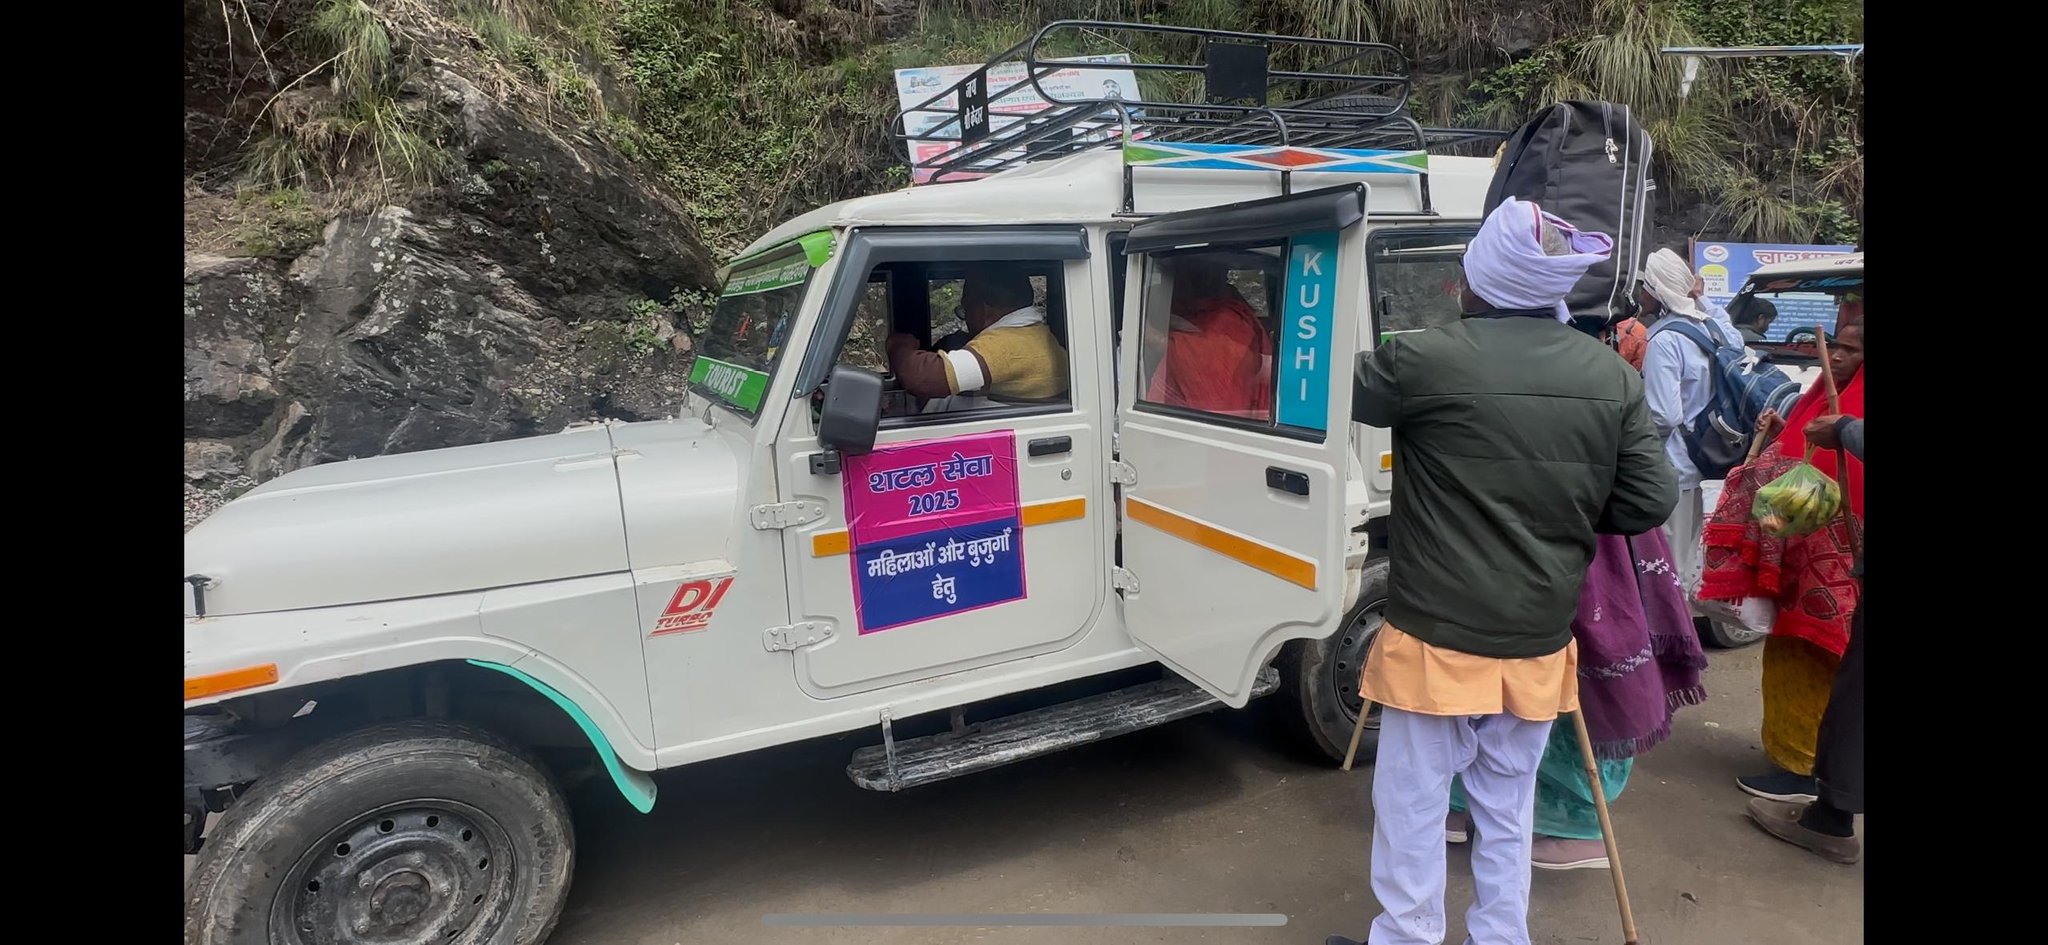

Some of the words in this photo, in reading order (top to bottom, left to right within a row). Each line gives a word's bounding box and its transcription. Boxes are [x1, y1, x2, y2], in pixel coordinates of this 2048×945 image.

[965, 78, 977, 98] जय
[971, 105, 983, 127] केदार
[1295, 252, 1322, 401] KUSHI
[704, 363, 748, 398] TOURIST
[869, 463, 937, 492] शटल
[942, 451, 993, 481] सेवा
[908, 489, 960, 517] 2025
[867, 541, 936, 577] महिलाओं
[938, 537, 965, 565] और
[661, 575, 735, 617] DI
[931, 573, 957, 604] हेतु
[656, 611, 713, 629] TURBO
